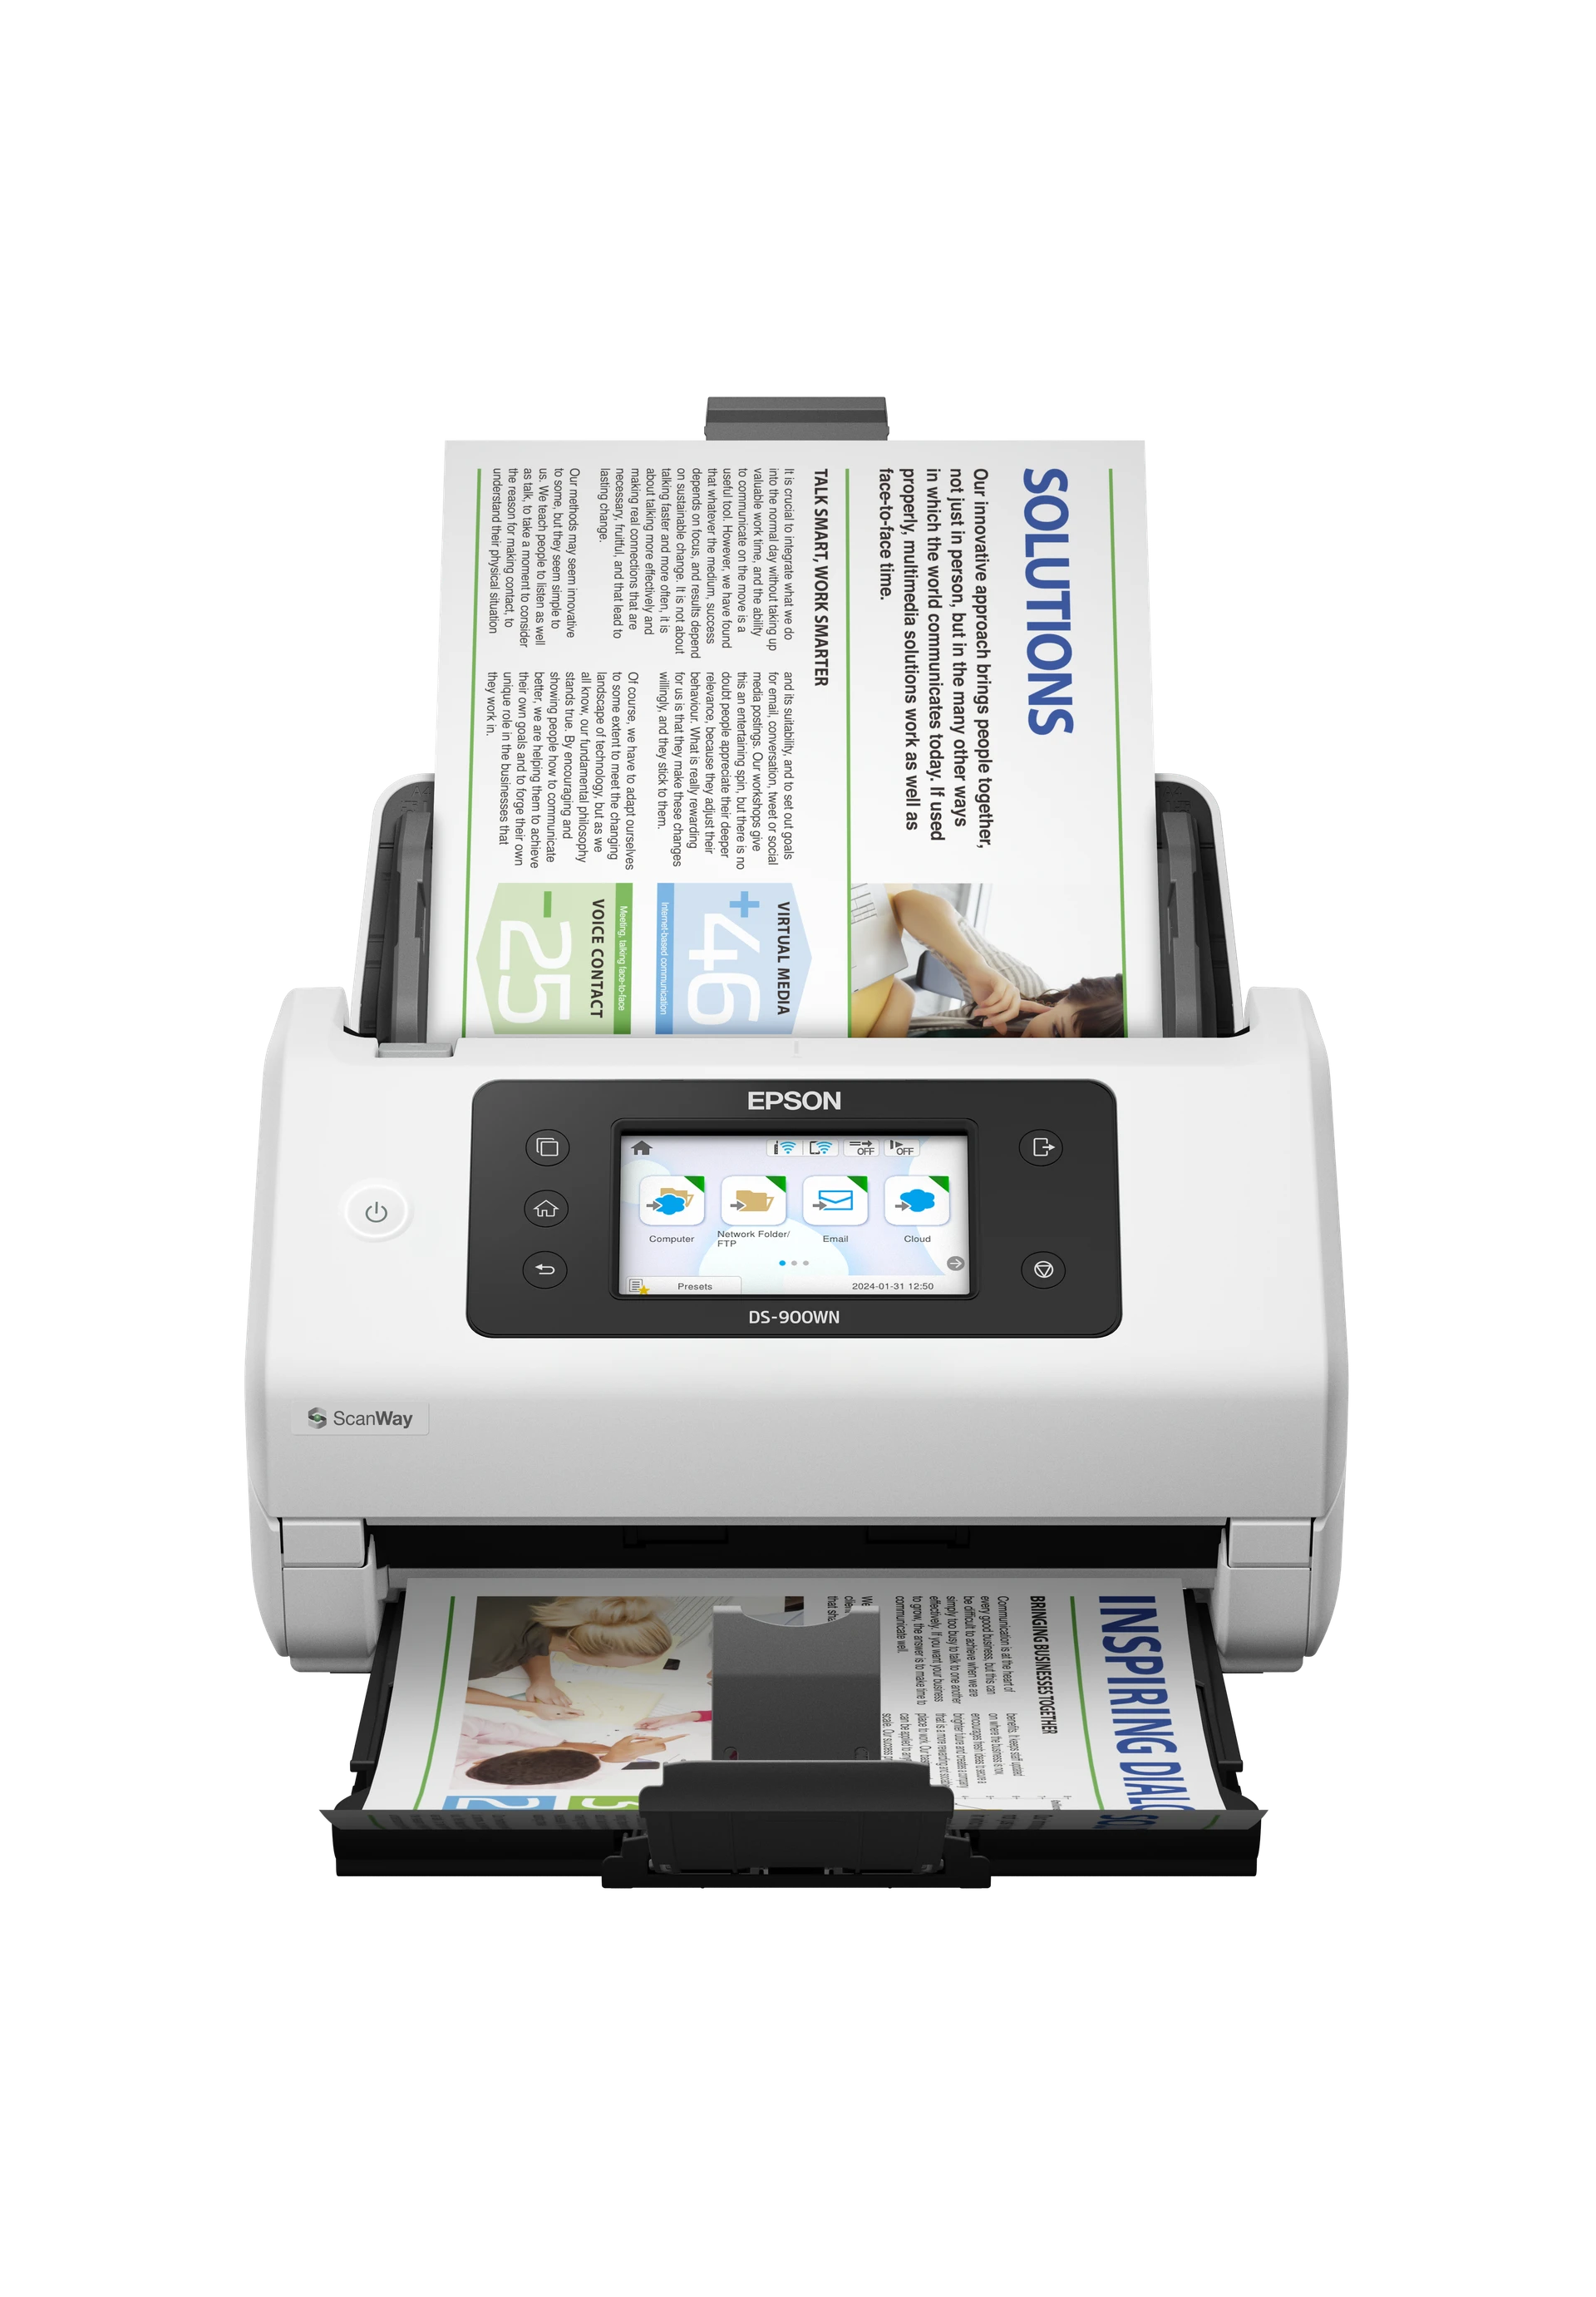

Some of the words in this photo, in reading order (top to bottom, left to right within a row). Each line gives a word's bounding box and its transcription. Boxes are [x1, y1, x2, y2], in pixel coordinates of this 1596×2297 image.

[769, 468, 779, 486] into
[815, 468, 828, 505] TALK
[927, 469, 941, 481] in
[950, 469, 964, 493] not
[973, 469, 988, 496] Our
[754, 468, 764, 509] valuable
[769, 489, 779, 504] the
[785, 488, 795, 520] crucial
[879, 468, 894, 559] face-to-face
[899, 469, 918, 535] properly,
[927, 486, 942, 531] which
[947, 497, 965, 525] just
[753, 512, 764, 536] work
[769, 508, 779, 541] normal
[785, 524, 794, 533] to
[812, 509, 828, 562] SMART,
[928, 536, 942, 561] the
[951, 531, 965, 544] in
[974, 501, 989, 581] innovative
[751, 539, 764, 563] time,
[766, 545, 779, 563] day
[781, 536, 795, 579] integrate
[753, 567, 763, 585] and
[769, 566, 779, 602] without
[880, 563, 894, 600] time.
[904, 540, 919, 625] multimedia
[928, 565, 943, 609] world
[948, 550, 963, 607] person,
[753, 589, 763, 604] the
[784, 583, 795, 607] what
[815, 565, 828, 612] WORK
[1024, 468, 1073, 735] SOLUTIONS
[751, 608, 763, 636] ability
[766, 604, 779, 634] taking
[784, 610, 792, 624] we
[952, 613, 967, 638] but
[972, 585, 991, 658] approach
[766, 638, 776, 651] up
[784, 628, 795, 640] do
[815, 615, 829, 686] SMARTER
[953, 643, 967, 656] in
[769, 672, 779, 685] for
[904, 631, 919, 703] solutions
[928, 614, 943, 729] communicates
[953, 662, 968, 687] the
[784, 672, 795, 690] and
[973, 664, 992, 714] brings
[767, 688, 779, 717] email,
[784, 694, 794, 705] its
[949, 692, 964, 734] many
[781, 708, 795, 756] suitability,
[905, 708, 920, 747] work
[767, 721, 778, 788] conversation,
[926, 733, 944, 781] today.
[973, 720, 993, 773] people
[784, 760, 794, 778] and
[905, 752, 917, 770] as
[953, 739, 968, 781] other
[411, 786, 431, 797] A4
[784, 781, 794, 791] to
[906, 775, 921, 806] well
[930, 787, 945, 796] If
[1163, 786, 1182, 797] A4
[768, 791, 778, 819] tweet
[784, 795, 794, 810] set
[951, 786, 966, 826] ways
[975, 777, 993, 848] together,
[768, 822, 776, 833] or
[784, 813, 794, 829] out
[906, 812, 918, 831] as
[930, 802, 945, 840] used
[768, 835, 778, 865] social
[781, 832, 794, 860] goals
[592, 899, 604, 944] VOICE
[618, 906, 628, 938] Meeting,
[660, 902, 669, 956] Internet-based
[777, 902, 790, 963] VIRTUAL
[617, 940, 627, 964] talking
[590, 949, 604, 1018] CONTACT
[618, 966, 627, 1011] face-to-face
[660, 958, 668, 1014] communication
[777, 968, 790, 1015] MEDIA
[748, 1091, 841, 1111] EPSON
[857, 1147, 875, 1156] OFF
[896, 1147, 914, 1156] OFF
[649, 1235, 694, 1244] Computer
[749, 1310, 840, 1324] DS-900WN
[333, 1411, 413, 1428] ScanWay
[828, 1596, 839, 1608] that
[944, 1596, 958, 1617] simply
[963, 1596, 974, 1604] be
[978, 1596, 990, 1614] every
[895, 1596, 908, 1639] communicate
[909, 1604, 922, 1621] grow,
[928, 1596, 942, 1629] effectively.
[948, 1618, 958, 1629] too
[964, 1606, 976, 1629] difficult
[978, 1615, 994, 1632] good
[998, 1596, 1011, 1645] Communication
[1030, 1596, 1049, 1643] BRINGING
[914, 1623, 925, 1634] the
[946, 1631, 959, 1645] busy
[897, 1640, 909, 1653] well.
[914, 1635, 924, 1656] answer
[928, 1637, 940, 1648] you
[966, 1638, 978, 1660] achieve
[983, 1634, 994, 1661] business,
[932, 1649, 943, 1663] want
[949, 1654, 961, 1664] talk
[984, 1663, 996, 1672] but
[1002, 1660, 1013, 1669] the
[916, 1671, 927, 1687] make
[929, 1664, 942, 1678] your
[950, 1672, 959, 1683] one
[968, 1662, 979, 1678] when
[986, 1673, 997, 1684] this
[1002, 1671, 1014, 1686] heart
[1034, 1644, 1054, 1694] BUSINESSES
[1099, 1596, 1177, 1753] INSPIRING
[916, 1688, 928, 1699] time
[933, 1679, 945, 1702] business
[951, 1685, 963, 1704] another
[968, 1679, 978, 1688] we
[969, 1688, 978, 1697] are
[986, 1685, 996, 1694] can
[1038, 1696, 1057, 1734] TOGETHER
